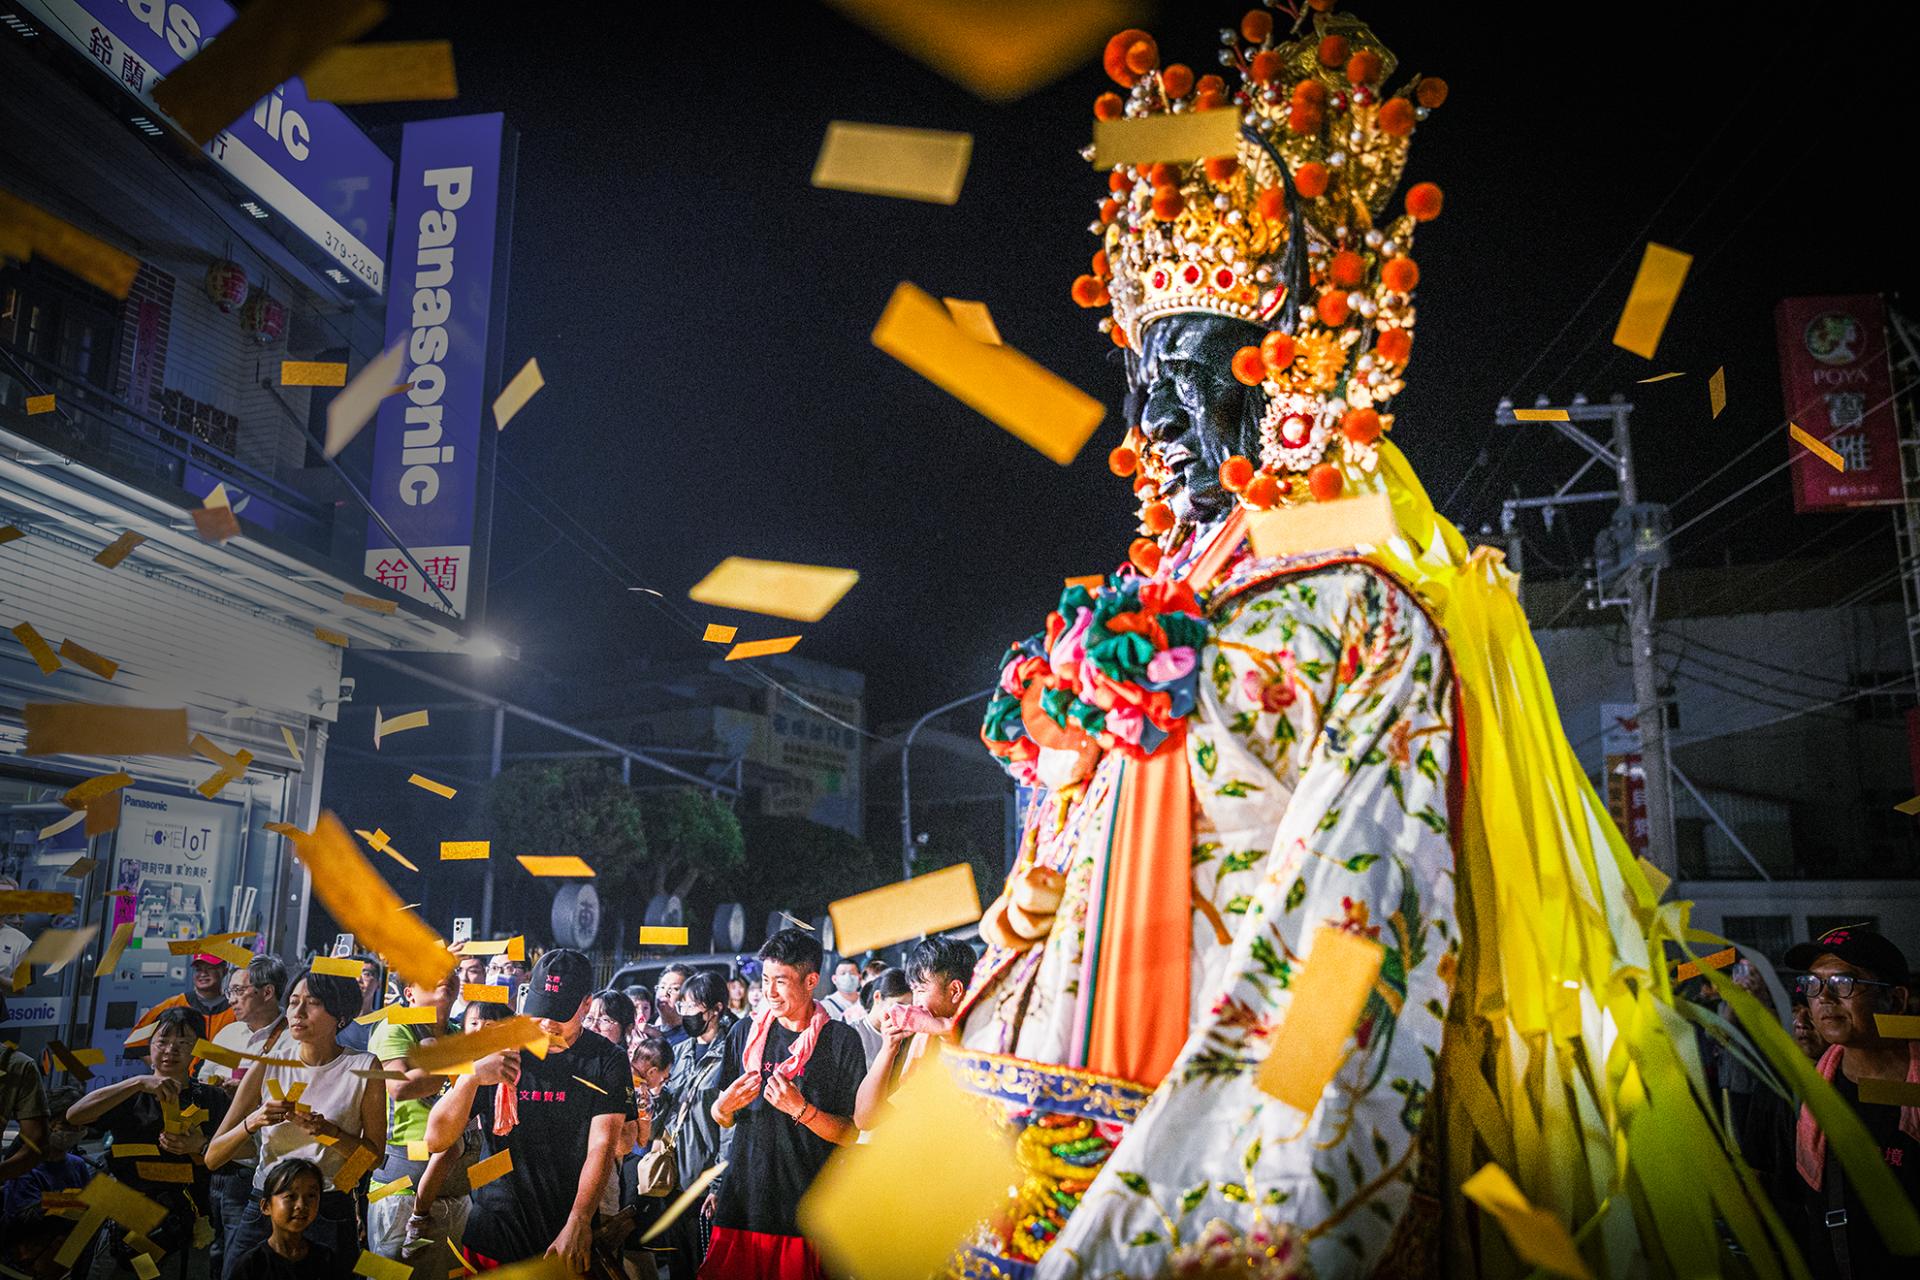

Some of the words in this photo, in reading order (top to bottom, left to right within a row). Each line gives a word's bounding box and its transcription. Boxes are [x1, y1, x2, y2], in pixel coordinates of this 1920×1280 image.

[325, 231, 379, 286] 379-2250
[400, 166, 473, 506] Panasonic
[1814, 370, 1868, 385] POYA
[376, 556, 459, 592] 鈴蘭
[124, 795, 168, 811] Panasonic
[8, 1003, 55, 1020] asonic
